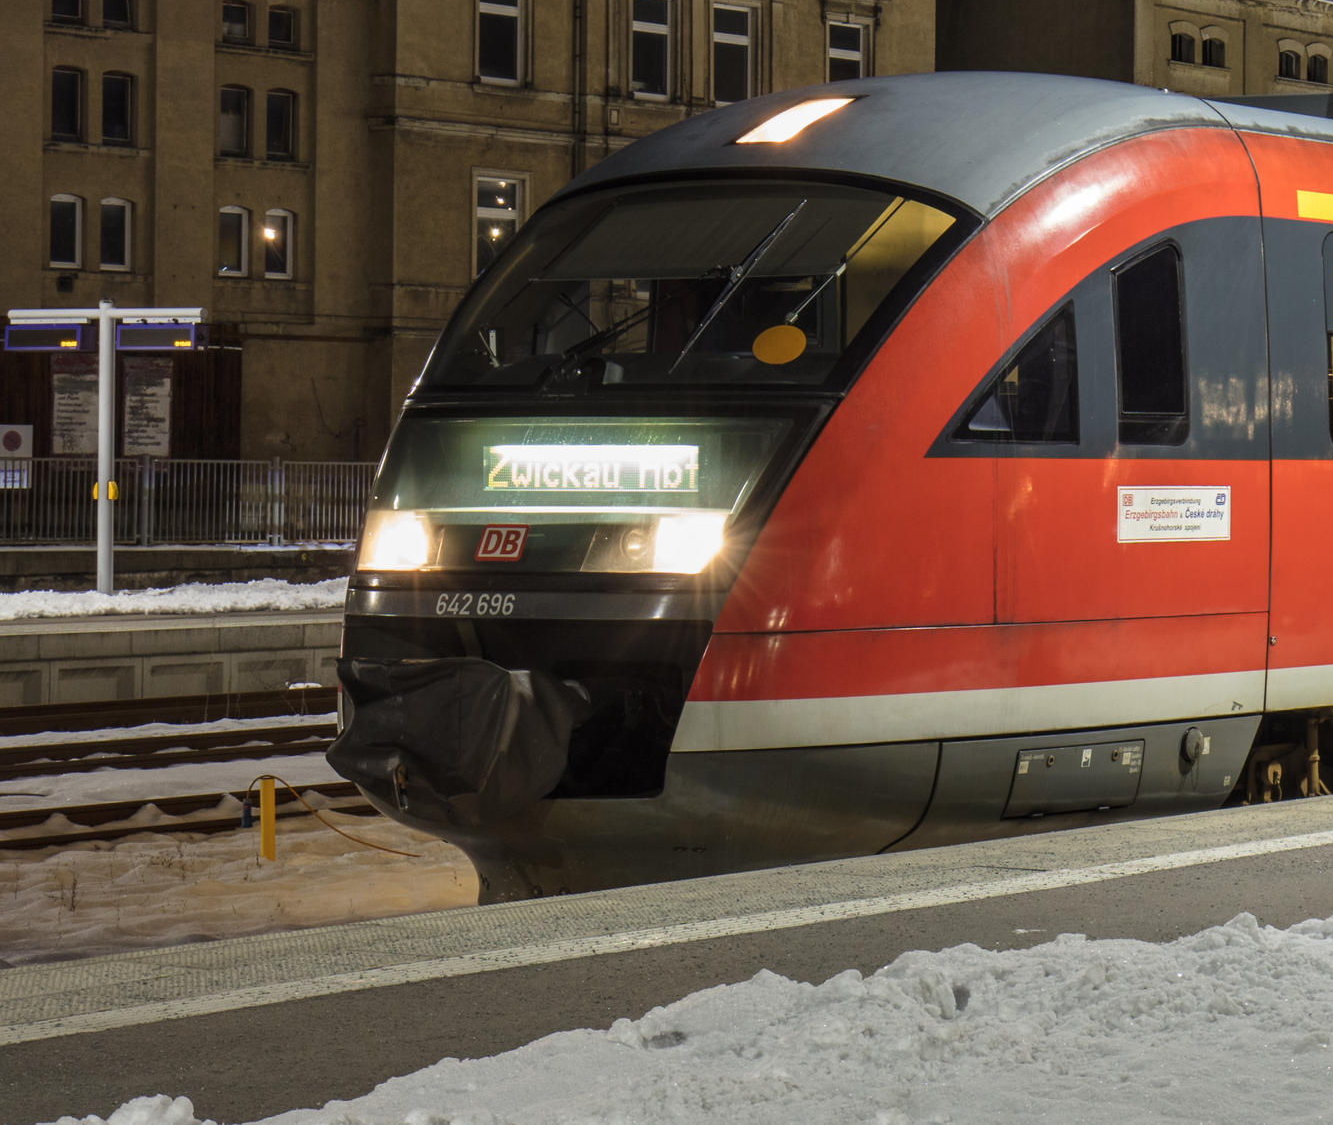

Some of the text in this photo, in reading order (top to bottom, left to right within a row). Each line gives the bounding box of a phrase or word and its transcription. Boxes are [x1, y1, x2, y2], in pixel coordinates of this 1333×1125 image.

[1125, 509, 1178, 521] Erzgebirgsbahn
[480, 529, 523, 556] DB
[436, 593, 516, 615] 642 696
